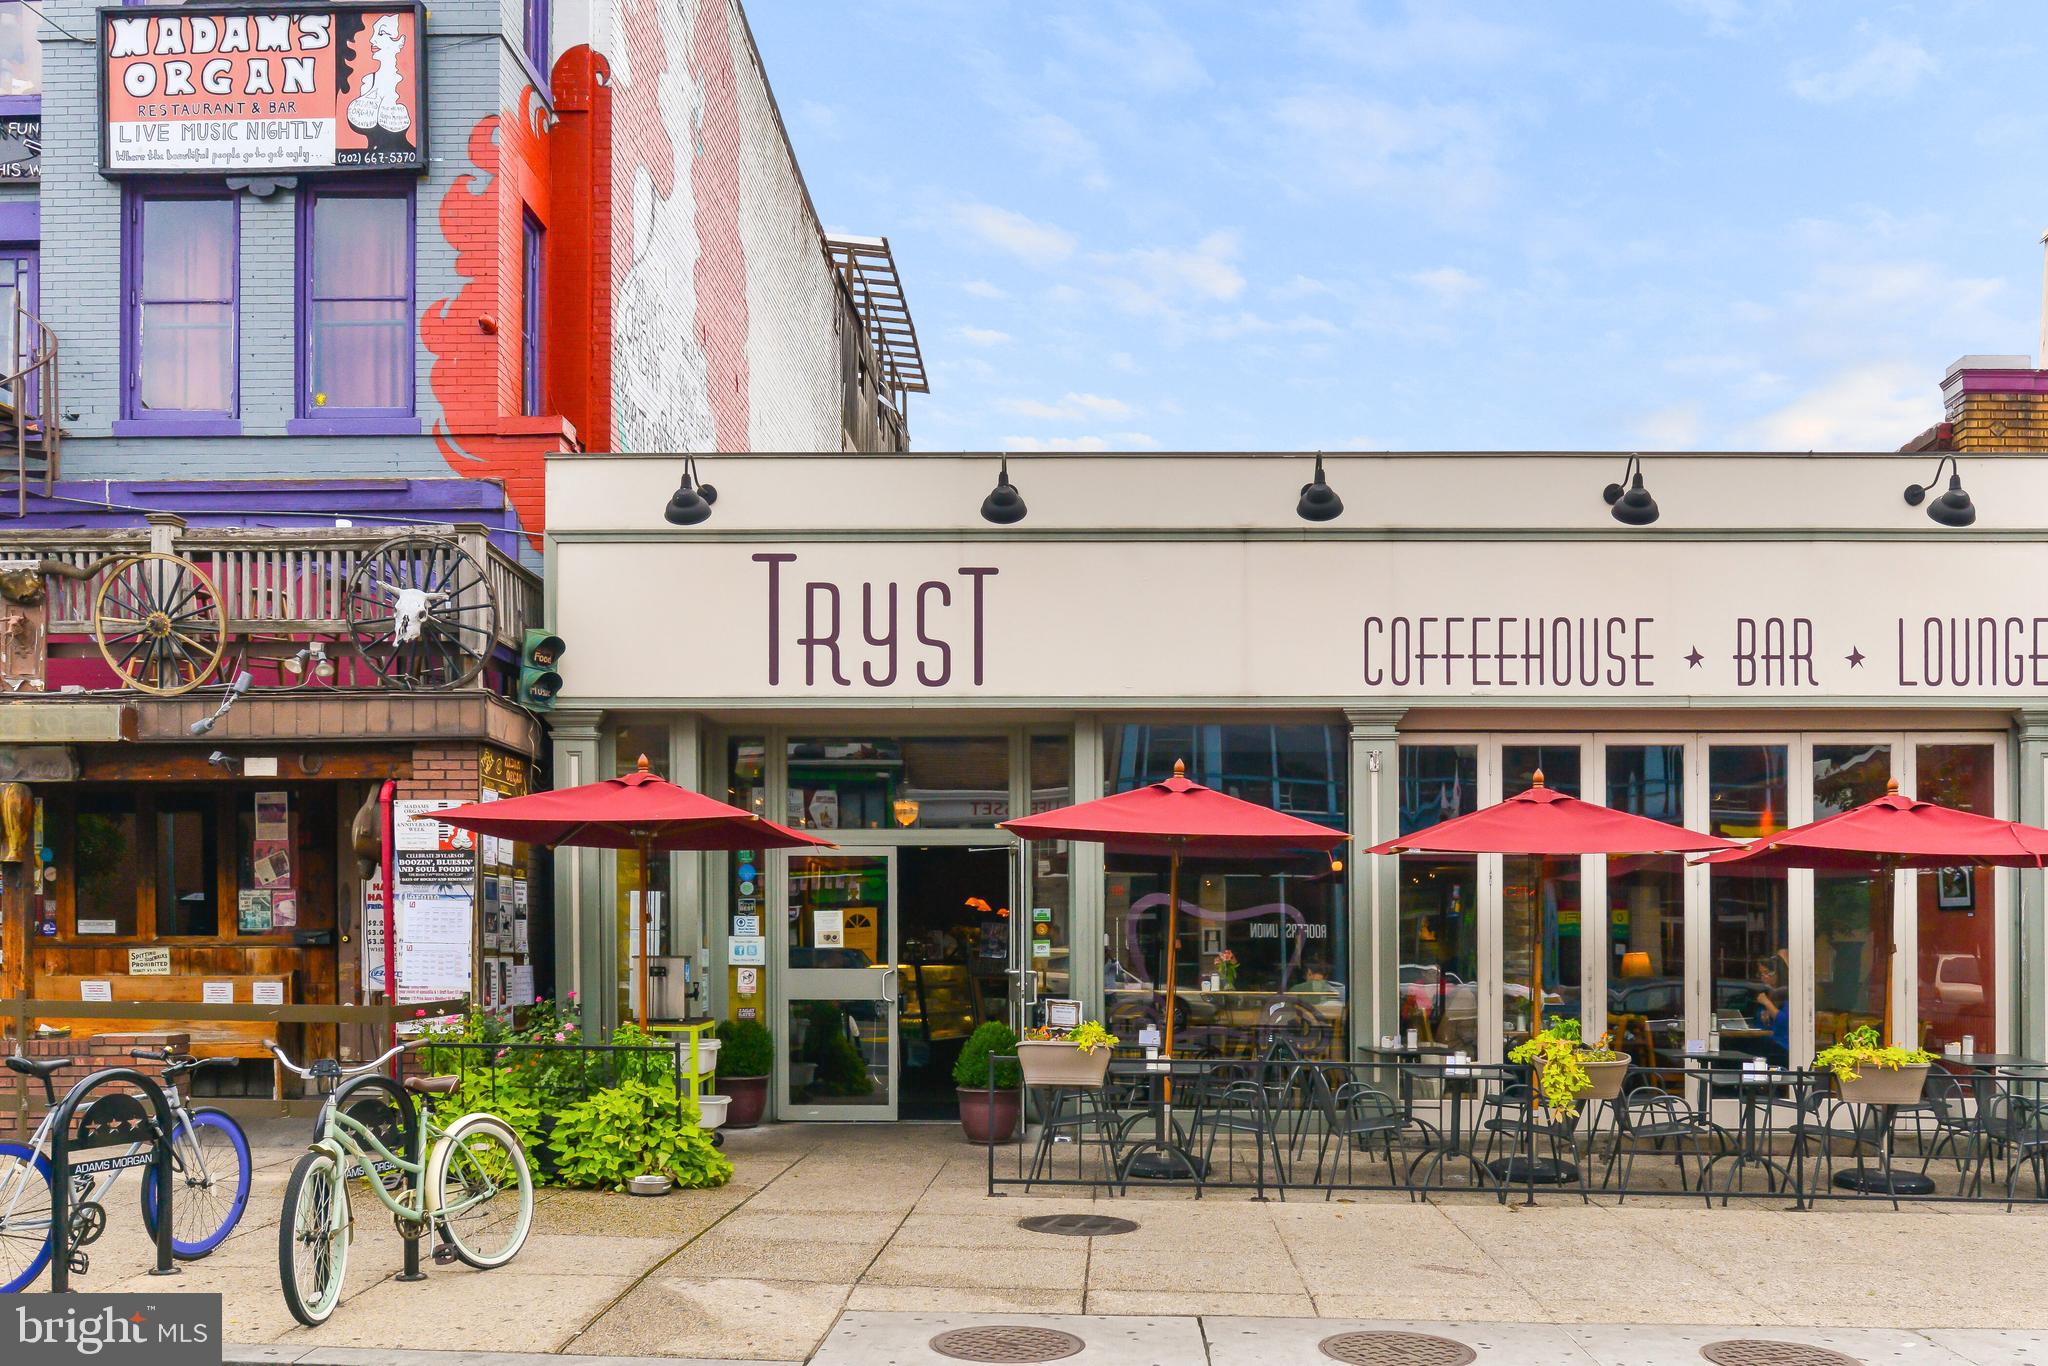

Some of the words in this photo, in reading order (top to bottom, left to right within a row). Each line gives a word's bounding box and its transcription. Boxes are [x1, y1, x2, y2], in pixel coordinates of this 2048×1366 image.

[110, 15, 331, 58] MADAM'S
[123, 58, 316, 97] ORGAN
[138, 102, 246, 117] RESTAURANT
[251, 102, 261, 114] &
[269, 101, 297, 114] BAR
[8, 122, 39, 135] FUN
[119, 123, 170, 143] LIVE
[181, 121, 239, 141] MUSIC
[246, 121, 324, 141] NIGHTLY
[115, 150, 146, 161] Where
[147, 149, 164, 160] the
[166, 148, 209, 162] beautiful
[212, 147, 241, 164] people
[243, 152, 254, 163] go
[254, 146, 266, 158] to
[267, 146, 284, 163] get
[338, 152, 361, 163] (202)
[364, 152, 416, 164] 667-5370
[752, 553, 999, 687] TRYST
[534, 649, 552, 664] Food
[1362, 616, 1655, 687] COFFEEHOUSE
[1732, 618, 1819, 687] BAR
[1898, 617, 2048, 687] LOUNGE
[75, 1161, 110, 1174] ADAMS
[112, 1154, 153, 1169] MORGAN
[346, 1167, 365, 1177] AMS
[374, 1161, 397, 1173] ORGA
